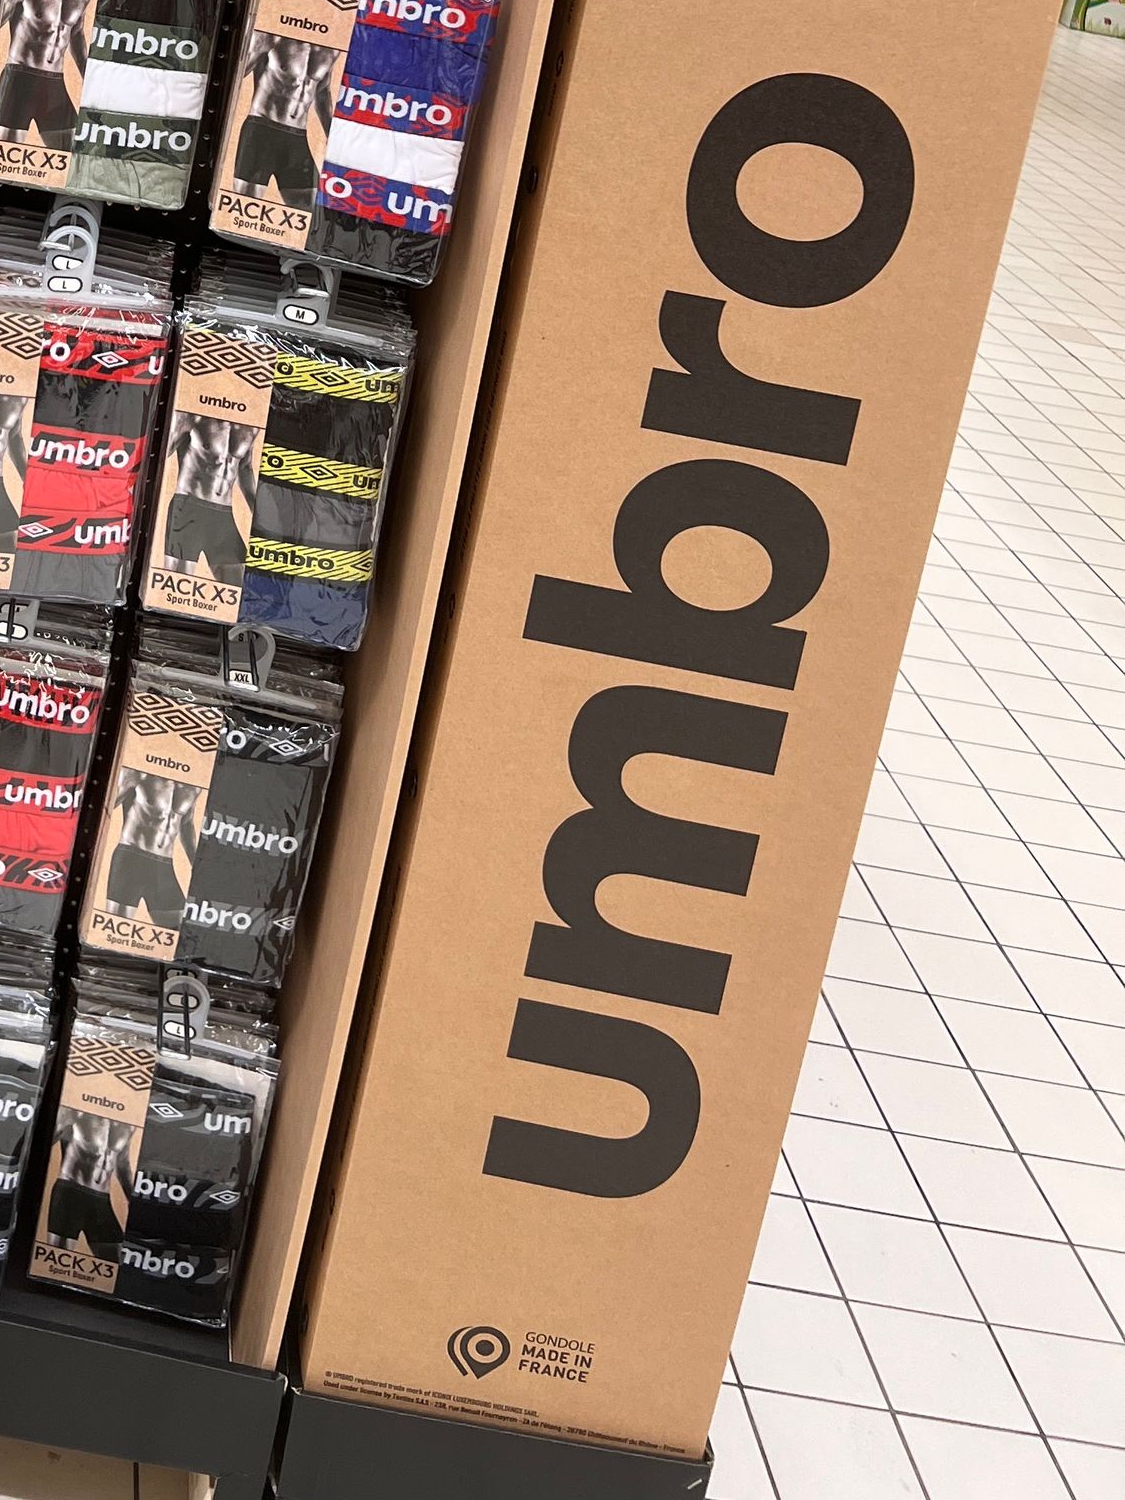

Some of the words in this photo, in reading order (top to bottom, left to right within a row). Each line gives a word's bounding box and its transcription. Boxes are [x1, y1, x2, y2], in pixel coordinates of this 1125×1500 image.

[280, 14, 328, 35] umbro
[40, 151, 67, 171] X3
[22, 166, 47, 178] Boxer
[218, 195, 274, 224] PACK
[280, 207, 308, 231] X3
[233, 216, 259, 231] Sport
[260, 222, 285, 237] Boxer
[66, 259, 71, 268] L
[62, 281, 67, 289] L
[296, 309, 305, 319] M
[199, 394, 247, 412] umbro
[249, 545, 334, 570] umbro
[151, 572, 207, 598] PACK
[212, 588, 238, 606] X3
[166, 593, 190, 608] Sport
[192, 598, 217, 612] Boxer
[481, 72, 915, 1199] umbro
[235, 672, 249, 682] XXL
[146, 754, 190, 773] umbro
[93, 913, 146, 942] PACK
[150, 930, 174, 947] X3
[176, 1027, 181, 1035] L
[82, 1092, 125, 1112] umbro
[134, 1172, 188, 1201] bro
[34, 1247, 87, 1270] PACK
[91, 1259, 114, 1278] X3
[525, 1332, 595, 1354] GONDOLE
[522, 1344, 570, 1364] MADE
[574, 1355, 592, 1368] IN
[518, 1360, 589, 1383] FRANCE
